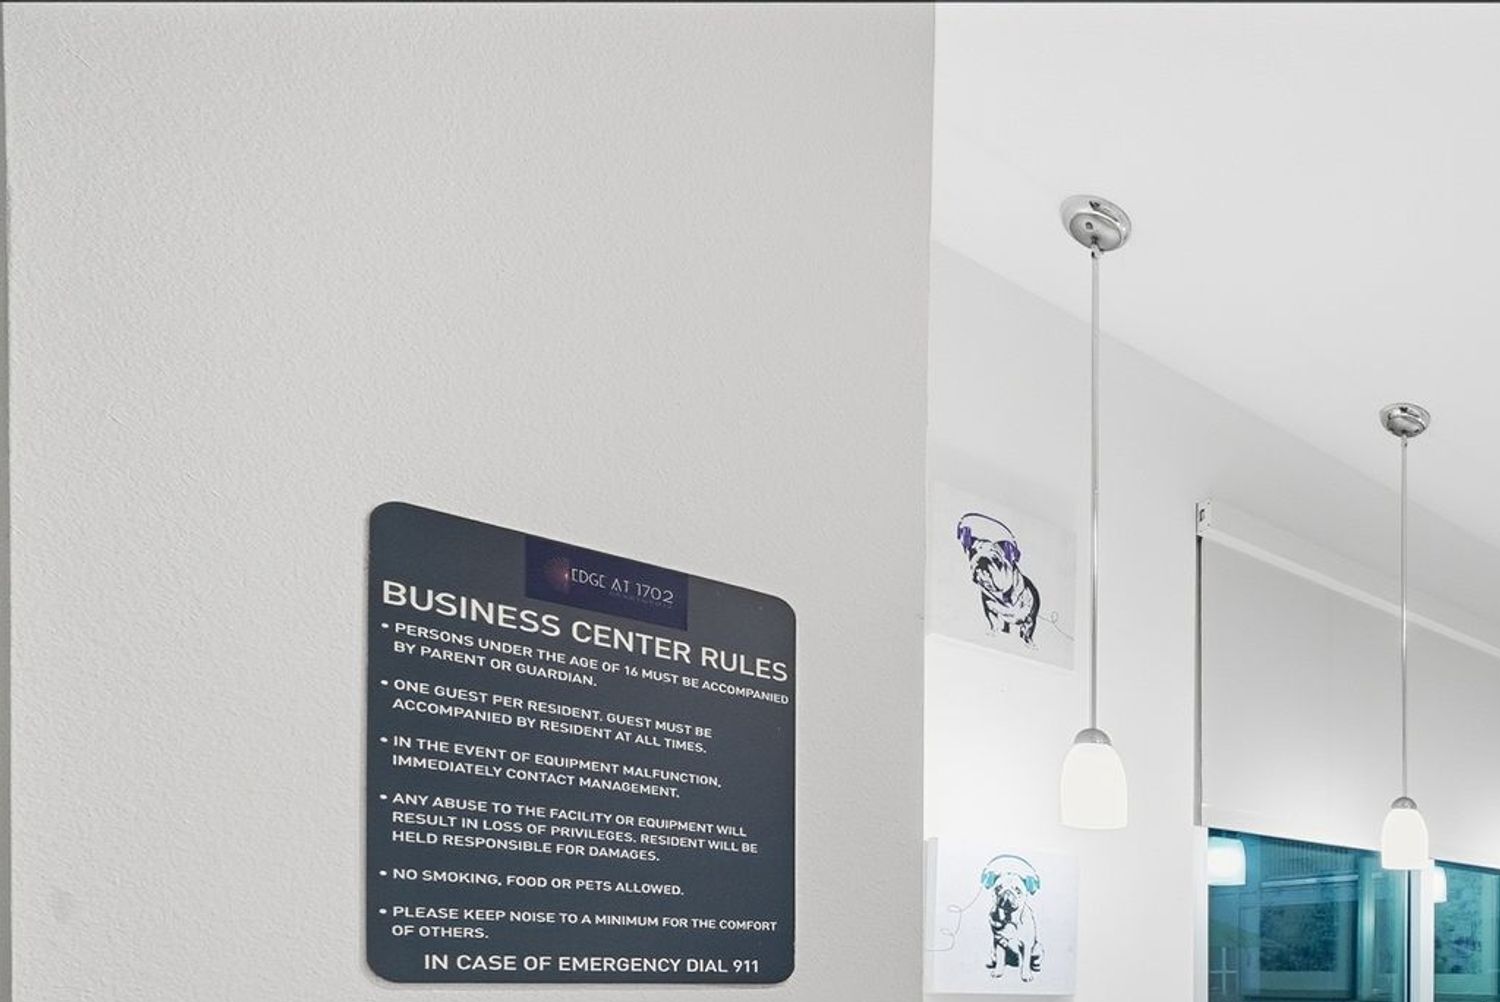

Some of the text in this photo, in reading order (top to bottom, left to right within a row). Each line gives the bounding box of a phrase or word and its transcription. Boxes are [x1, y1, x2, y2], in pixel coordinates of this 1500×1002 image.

[571, 567, 606, 589] EDGE
[610, 578, 629, 593] AT
[636, 582, 674, 604] 1702
[382, 579, 561, 638] BUSINESS
[571, 620, 692, 665] CENTER
[701, 646, 788, 682] RULES
[393, 640, 598, 687] BY PARENT OR GUARDIAN.
[394, 622, 790, 705] PERSONS UNDER THE AGE OF 16 MUST BE ACCOMPANIED
[391, 697, 707, 754] ACCOMPANIED BY RESIDENT AT ALL TIMES.
[393, 678, 431, 695] ONE
[433, 685, 489, 704] GUEST
[492, 694, 524, 710] PER
[606, 712, 653, 729] GUEST
[654, 719, 693, 735] MUST
[694, 726, 713, 739] BE
[392, 754, 680, 799] IMMEDIATELY CONTACT MANAGEMENT.
[393, 735, 412, 749] IN
[415, 738, 450, 753] THE
[453, 742, 508, 761] EVENT
[510, 750, 531, 763] OF
[534, 753, 620, 775] EQUIPMENT
[392, 792, 748, 838] ANY ABUSE TO THE FACILITY OR EQUIPMENT WILL
[392, 810, 758, 854] RESULT IN LOSS OF PRIVILEGES. RESIDENT WILL BE
[392, 830, 661, 862] HELD RESPONSIBLE FOR DAMAGES.
[392, 867, 418, 881] NO
[506, 874, 548, 888] FOOD
[550, 877, 572, 890] OR
[575, 878, 613, 892] PETS
[614, 881, 685, 896] ALLOWED.
[391, 924, 489, 939] OF OTHERS.
[392, 905, 778, 932] PLEASE KEEP NOISE TO A MINIMUM FOR THE COMFORT
[424, 953, 759, 973] IN CASE OF EMERGENCY DIAL 911
